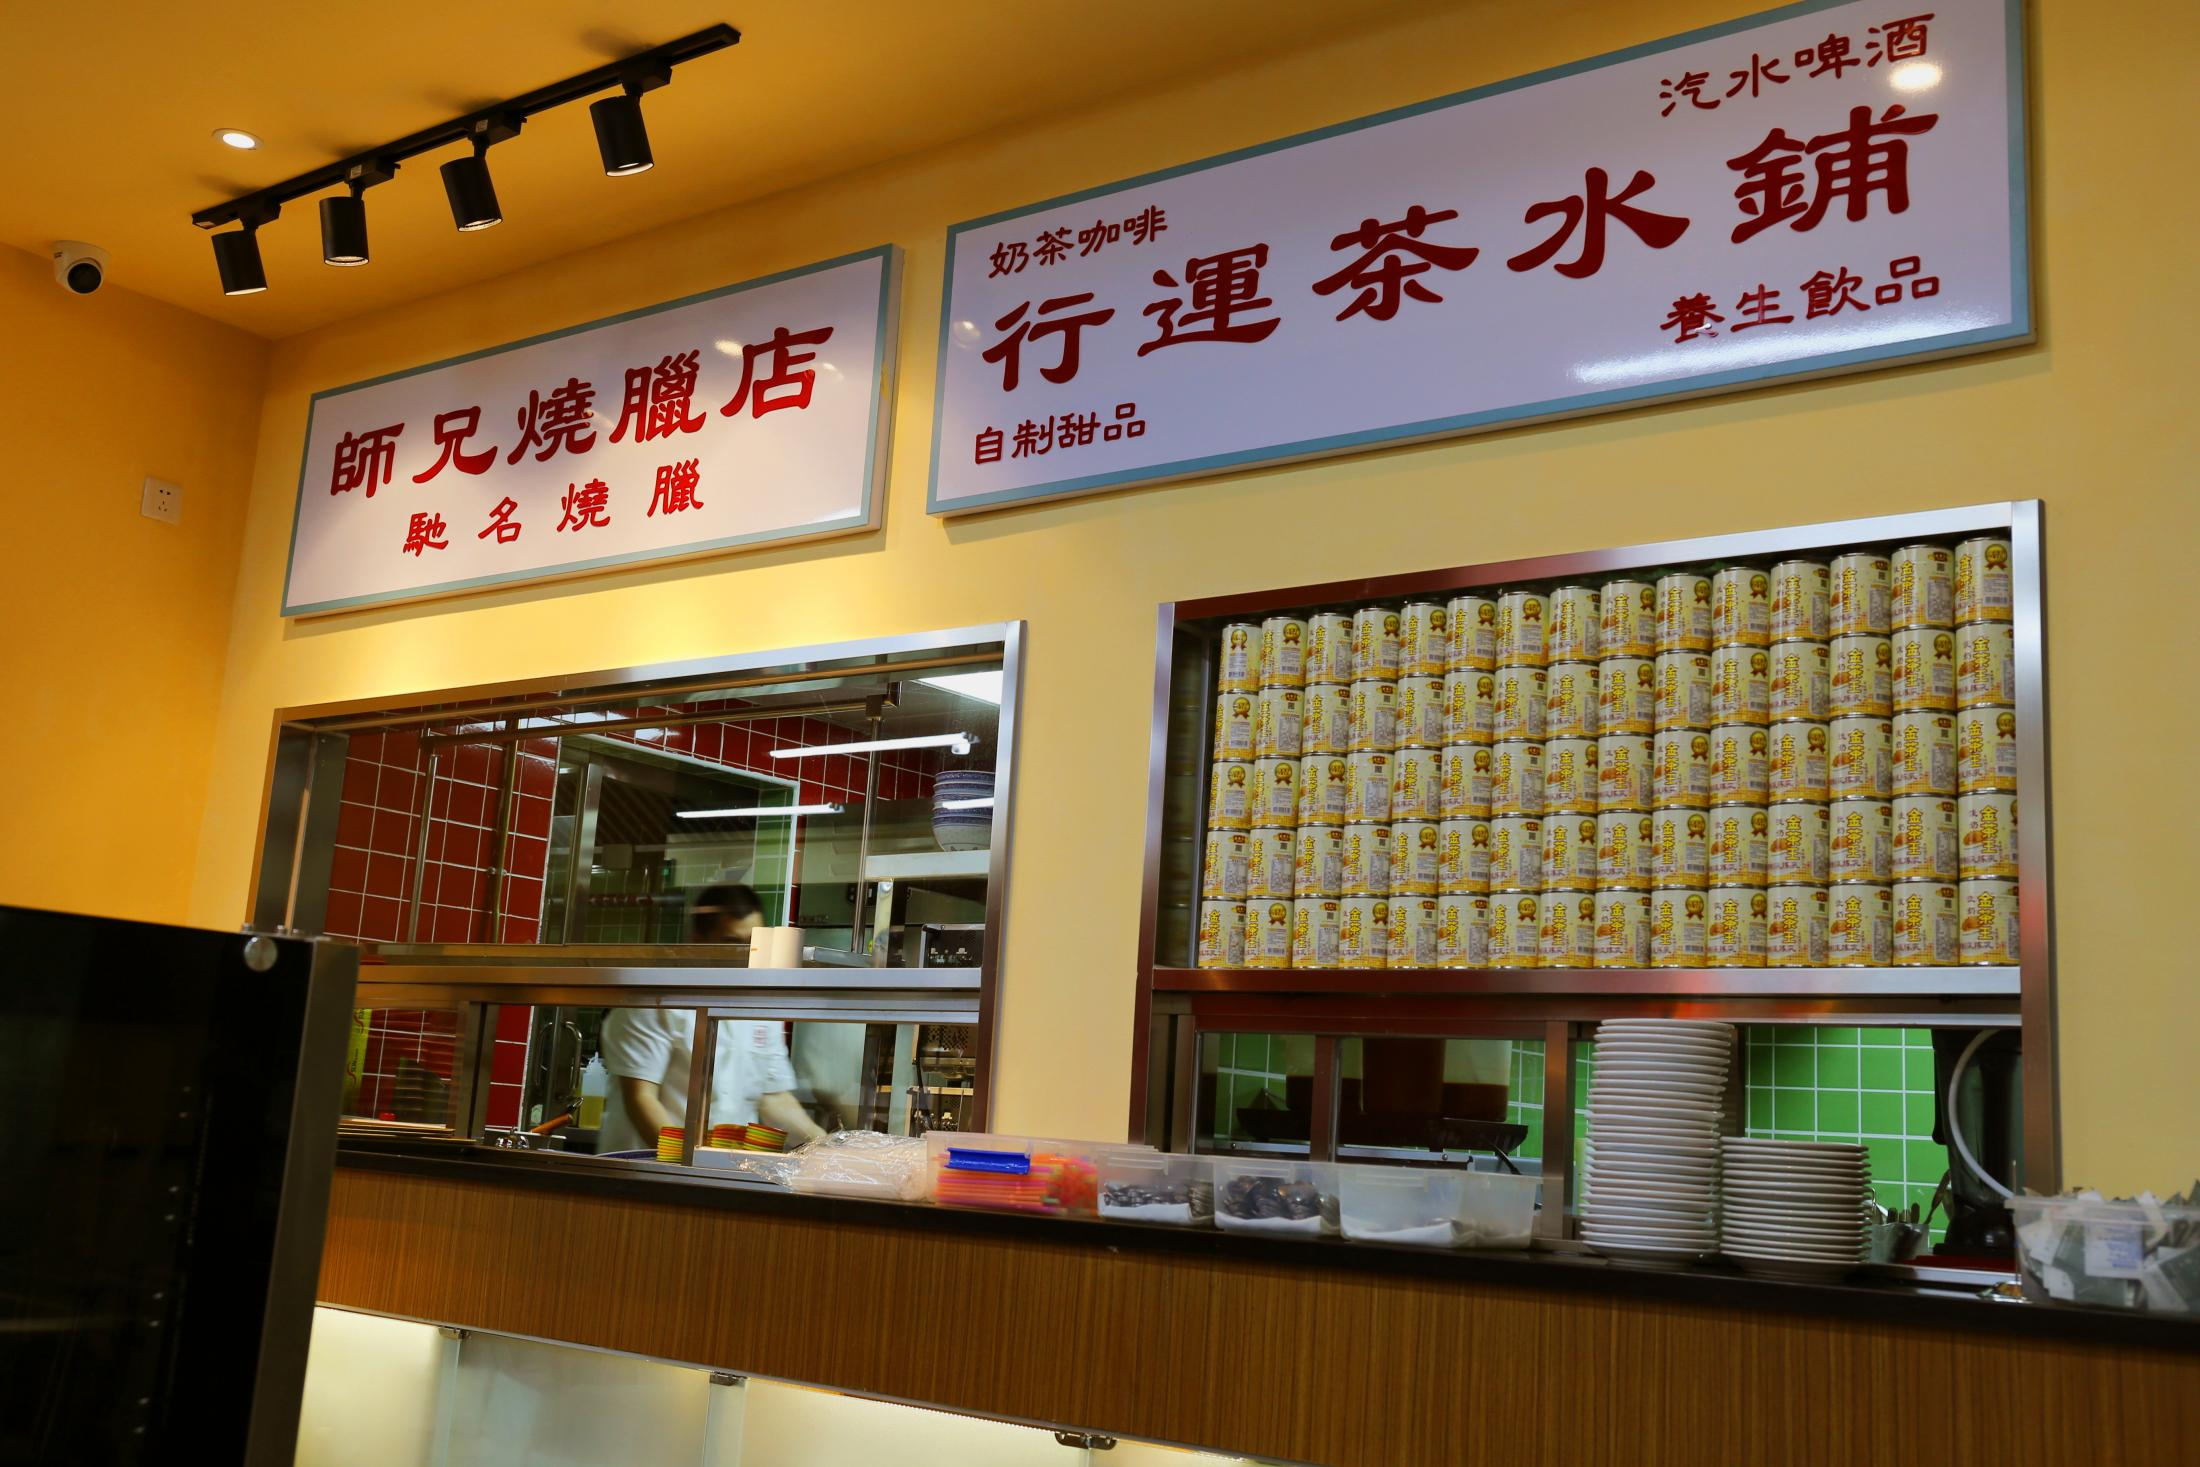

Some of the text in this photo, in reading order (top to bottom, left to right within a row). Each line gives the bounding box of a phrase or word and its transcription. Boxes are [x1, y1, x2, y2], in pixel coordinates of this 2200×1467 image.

[1660, 13, 1936, 117] 汽水啤酒
[982, 105, 1939, 392] 行運茶水鋪
[988, 205, 1169, 279] 奶茶咖啡
[1660, 255, 1940, 344] 養生飲品
[329, 326, 835, 498] 師兄燒臘店
[974, 402, 1147, 465] 自制甜品
[402, 457, 705, 557] 馳名燒臘
[1665, 741, 1679, 786] 金茶王
[1722, 737, 1737, 781] 金茶王
[1780, 734, 1795, 780] 金茶王
[1848, 729, 1865, 775] 金茶王
[1903, 725, 1919, 772] 金茶王
[1969, 720, 1984, 768] 金茶王
[1404, 759, 1418, 800] 金茶王
[1450, 755, 1463, 797] 金茶王
[1500, 752, 1511, 793] 金茶王
[1560, 749, 1574, 793] 金茶王
[1615, 745, 1629, 790] 金茶王
[1448, 830, 1461, 873] 金茶王
[1497, 828, 1509, 870] 金茶王
[1554, 826, 1568, 869] 金茶王
[1612, 822, 1628, 867] 金茶王
[1662, 820, 1676, 865] 金茶王
[1723, 818, 1739, 862] 金茶王
[1786, 815, 1802, 861] 金茶王
[1846, 812, 1863, 859] 金茶王
[1906, 808, 1923, 856] 金茶王
[1980, 805, 1998, 854] 金茶王
[1397, 832, 1408, 874] 金茶王
[1395, 907, 1407, 948] 金茶王
[1446, 905, 1458, 948] 金茶王
[1495, 904, 1506, 947] 金茶王
[1552, 902, 1568, 946] 金茶王
[1609, 901, 1626, 946] 金茶王
[1660, 900, 1674, 946] 金茶王
[1723, 899, 1739, 944] 金茶王
[1782, 897, 1799, 943] 金茶王
[1844, 896, 1861, 942] 金茶王
[1906, 894, 1923, 942] 金茶王
[1977, 891, 1995, 941] 金茶王
